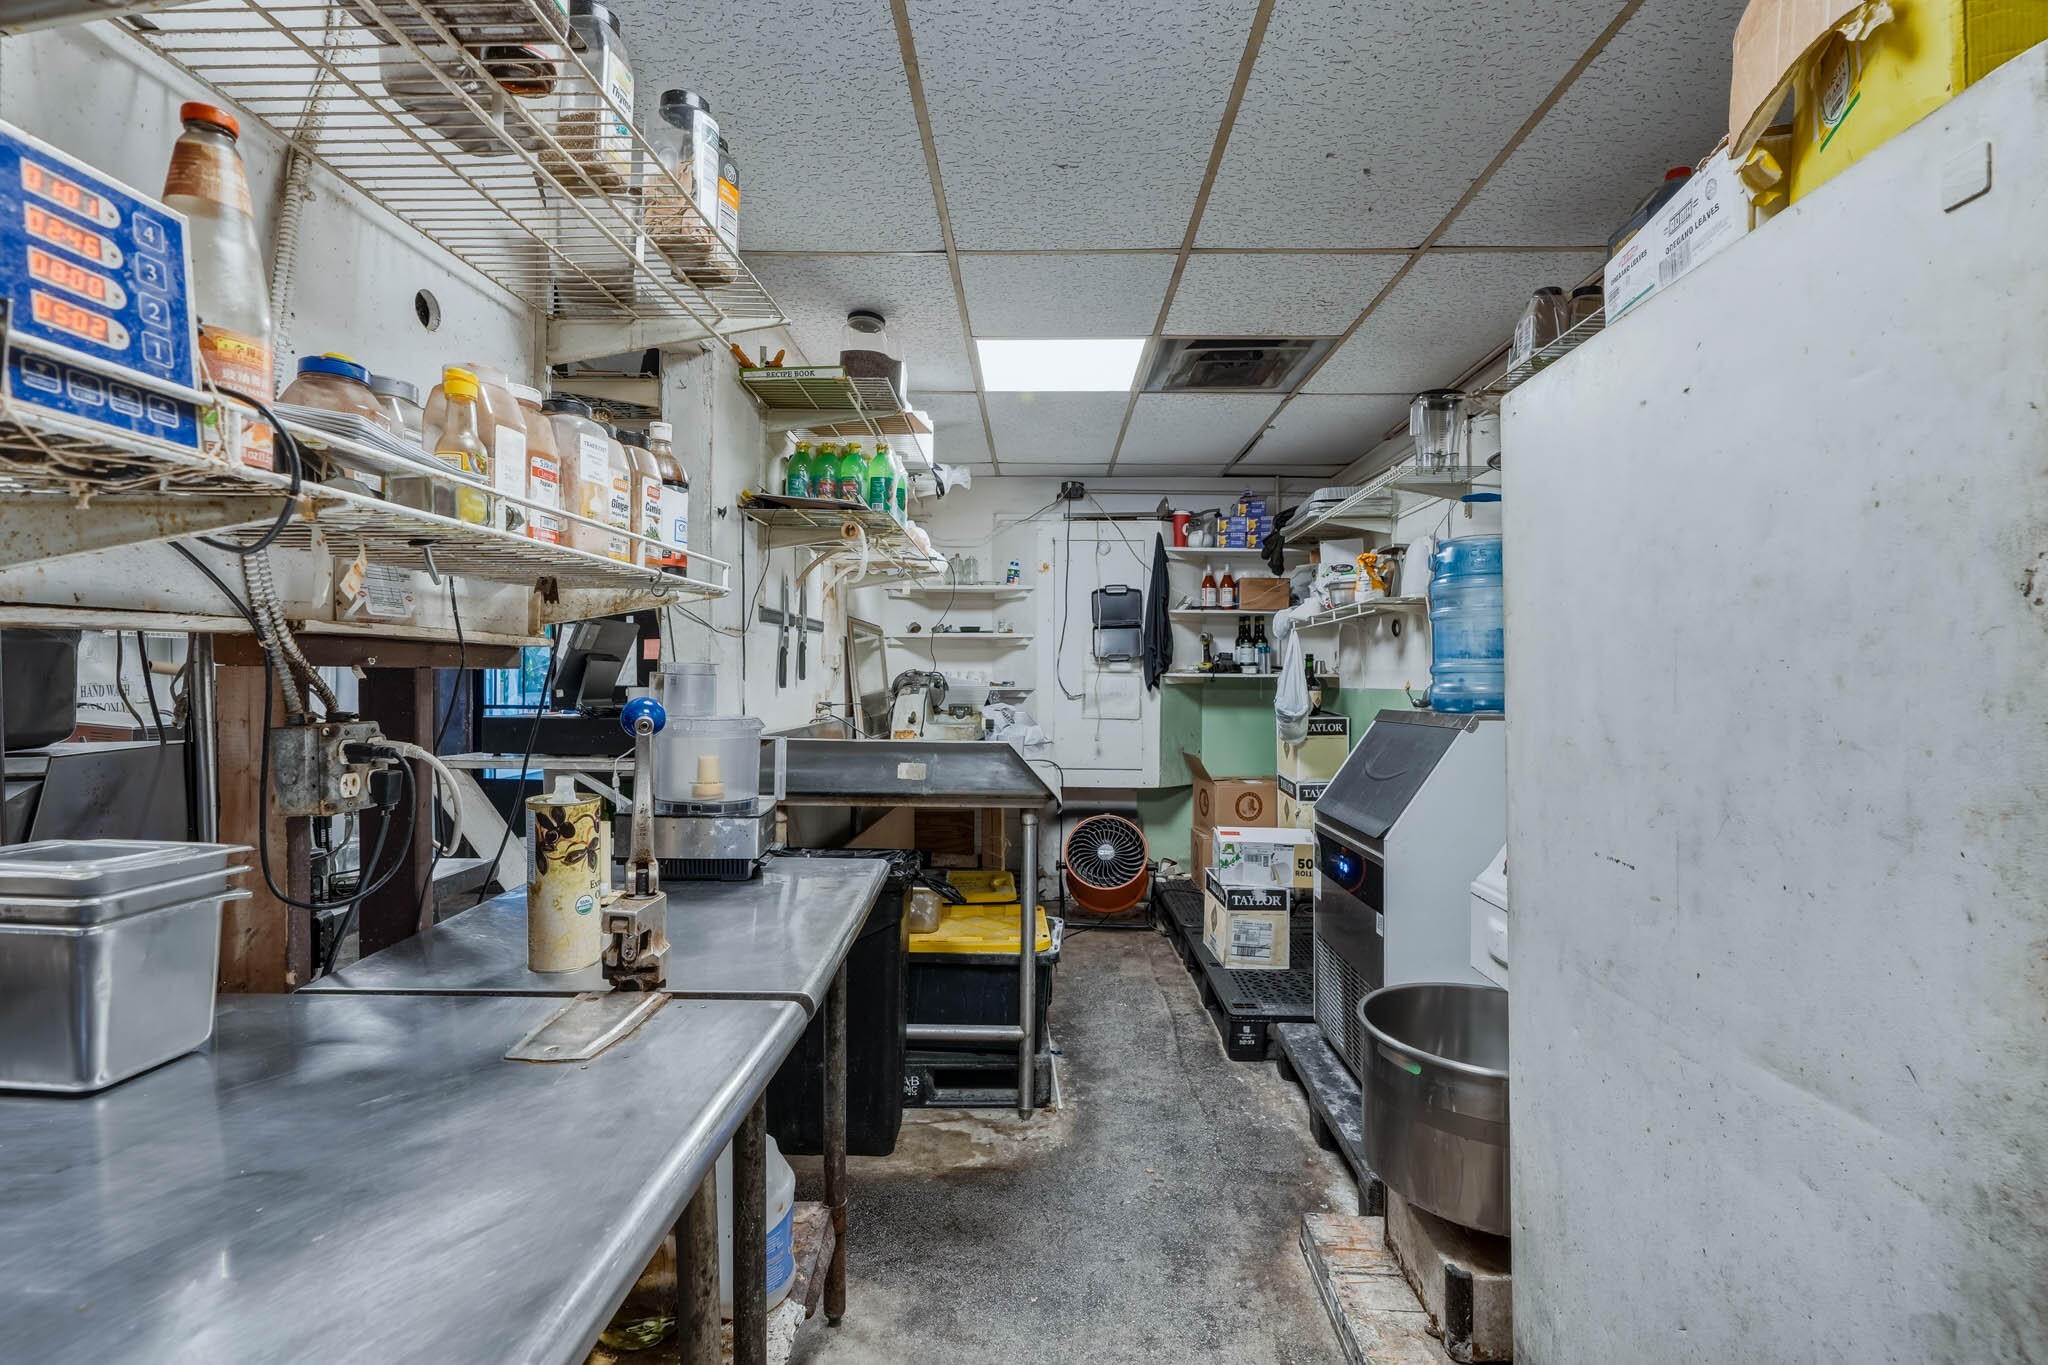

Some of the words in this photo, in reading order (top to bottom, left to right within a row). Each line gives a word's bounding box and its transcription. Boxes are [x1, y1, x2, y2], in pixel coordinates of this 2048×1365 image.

[612, 83, 632, 113] Thyme
[143, 227, 154, 242] 4
[1665, 226, 1693, 255] OREGANO
[1694, 202, 1720, 230] LEAVES
[146, 264, 157, 281] 3
[149, 303, 160, 321] 2
[152, 342, 162, 360] 1
[611, 499, 629, 512] Ginger
[80, 685, 104, 698] HAND
[1298, 858, 1313, 869] 50
